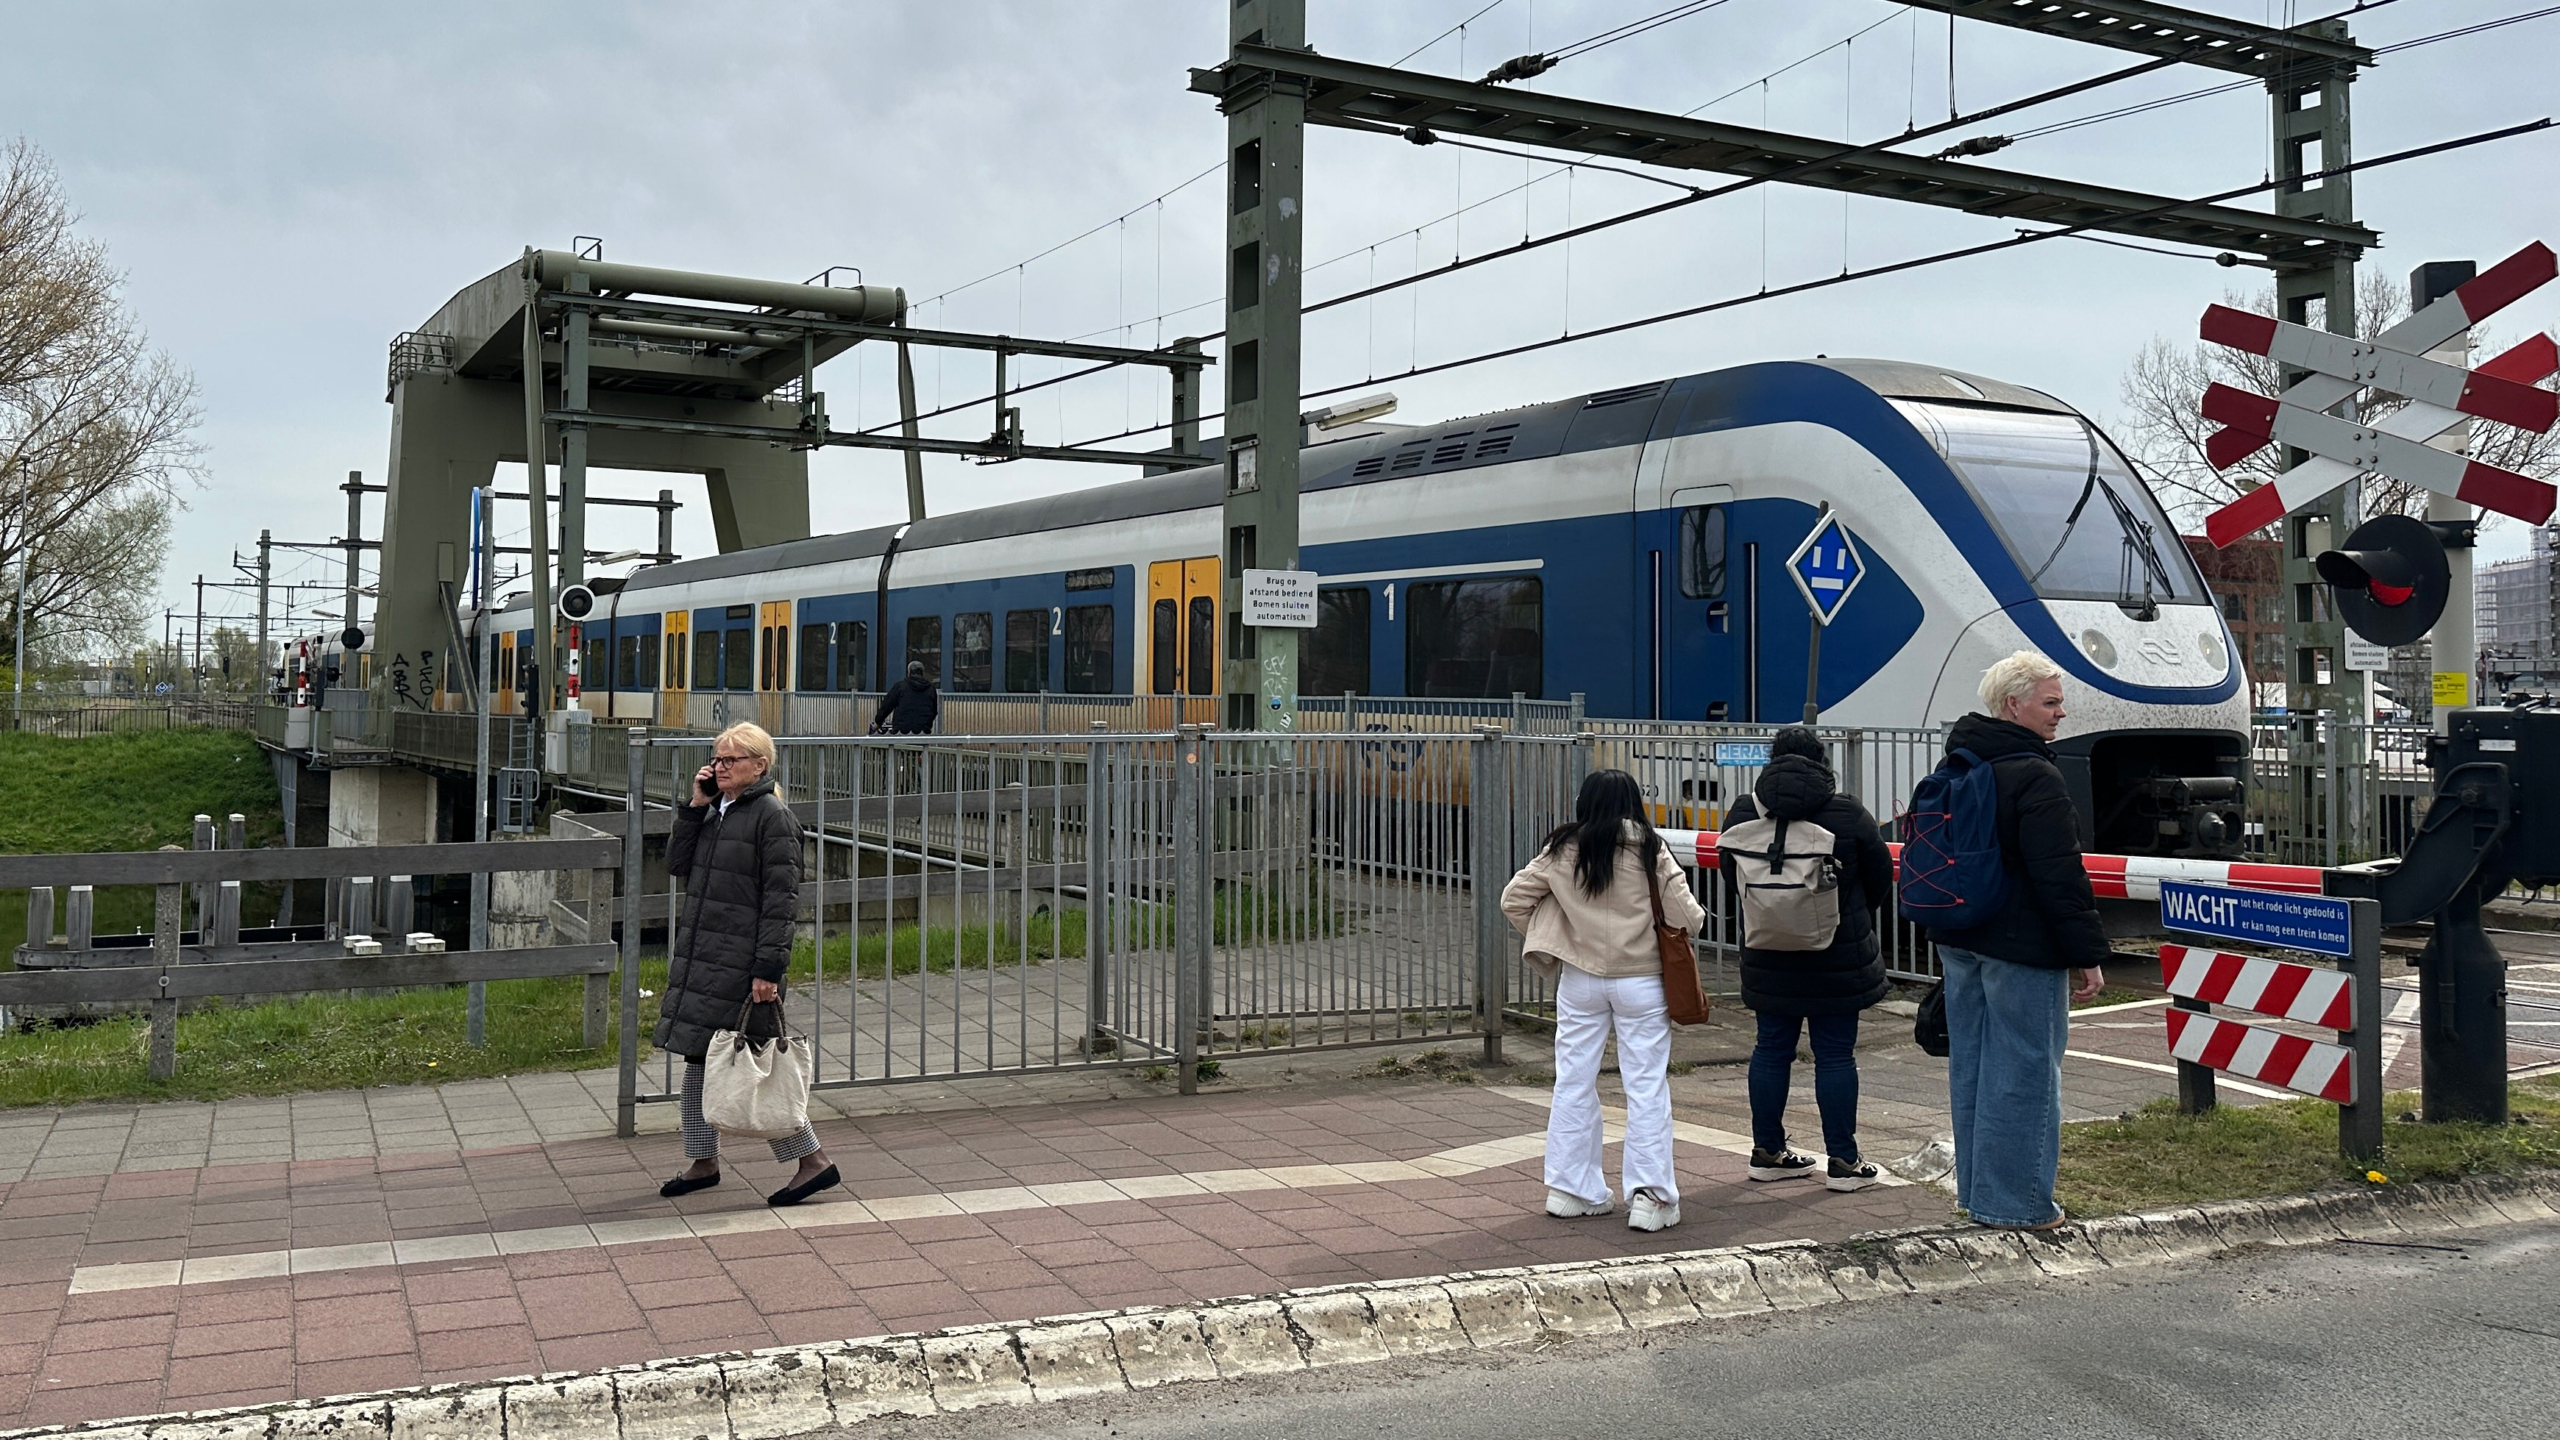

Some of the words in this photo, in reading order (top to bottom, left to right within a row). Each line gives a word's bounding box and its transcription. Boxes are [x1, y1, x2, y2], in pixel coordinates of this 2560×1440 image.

[1266, 576, 1285, 587] Brug
[1286, 579, 1297, 587] op
[1249, 588, 1280, 597] afstand
[1281, 589, 1313, 598] bediend
[1253, 600, 1280, 609] Bomen
[1281, 601, 1310, 610] sluiten
[1383, 583, 1395, 621] 1
[1052, 606, 1062, 636] 2
[1256, 613, 1306, 622] automatisch
[830, 621, 837, 645] 2
[586, 639, 592, 656] 2
[636, 635, 641, 653] 2
[1718, 744, 1772, 759] HERAS
[2165, 890, 2238, 927] WACHT
[2240, 897, 2252, 909] tot
[2252, 898, 2265, 911] het
[2265, 901, 2283, 913] rode
[2284, 901, 2302, 915] licht
[2302, 905, 2336, 919] gedoofd
[2336, 908, 2344, 920] is
[2241, 920, 2250, 930] er
[2250, 919, 2264, 932] kan
[2265, 924, 2280, 937] nog
[2281, 926, 2296, 937] een
[2297, 926, 2317, 939] trein
[2317, 928, 2346, 944] komen
